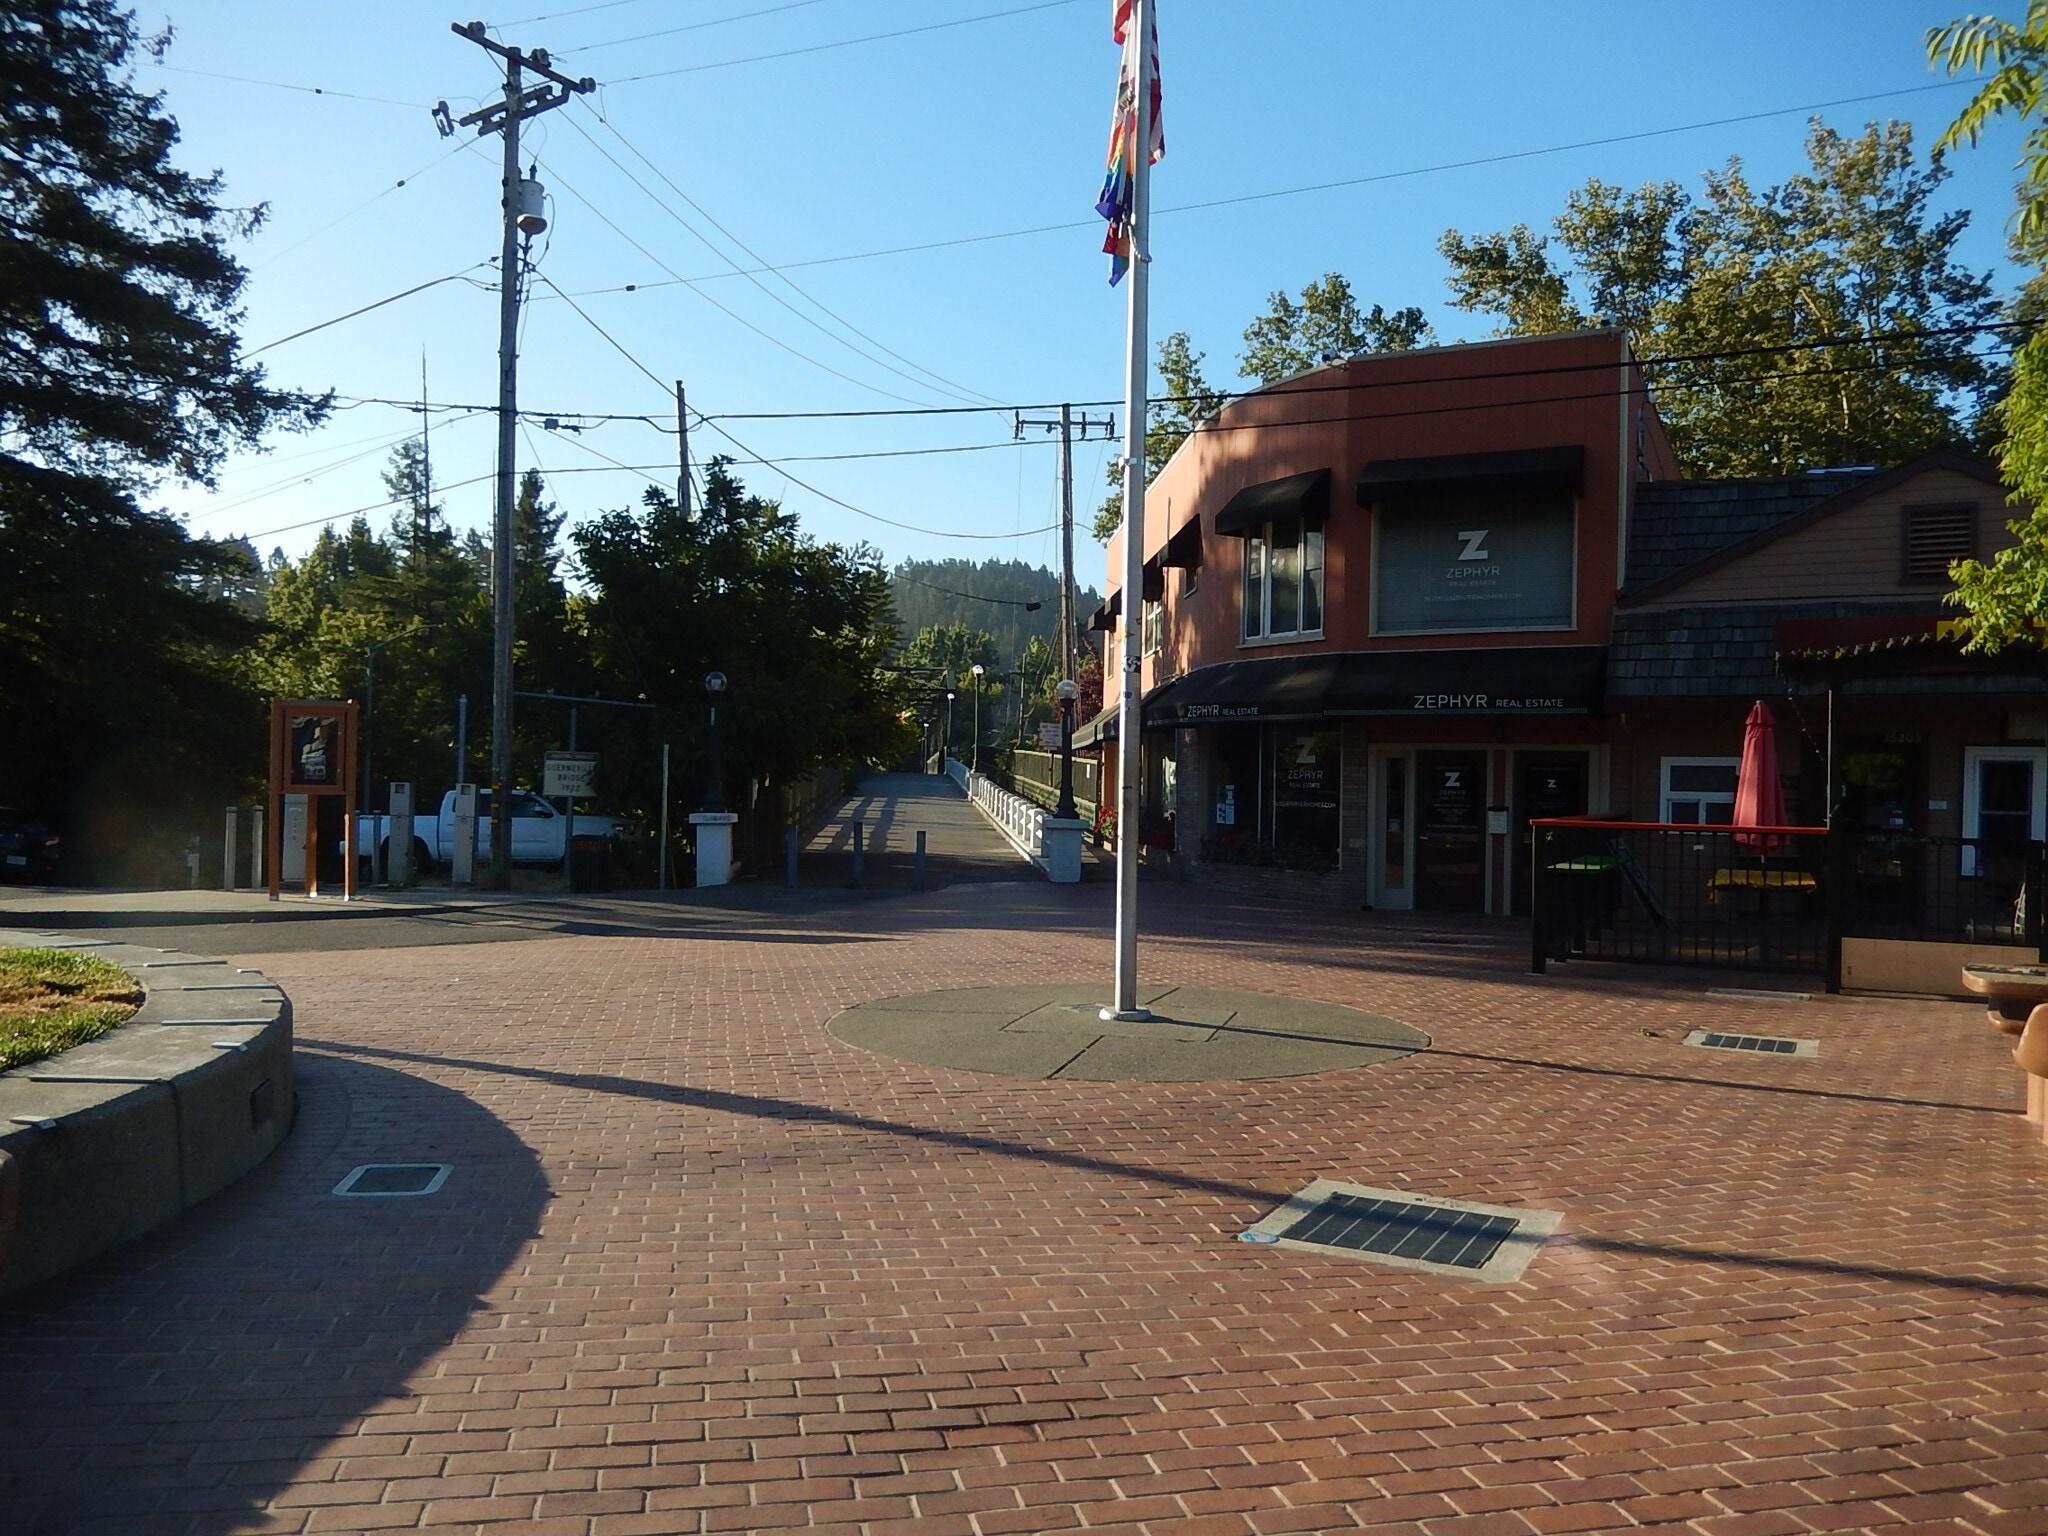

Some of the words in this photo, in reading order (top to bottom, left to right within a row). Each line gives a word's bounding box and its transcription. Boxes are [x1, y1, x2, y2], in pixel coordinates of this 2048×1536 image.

[1458, 530, 1489, 561] Z
[1446, 566, 1500, 579] ZEPHYR
[1413, 694, 1488, 709] ZEPHYR
[1496, 699, 1523, 708] REAL
[1525, 698, 1564, 708] ESTATE
[1187, 704, 1220, 718] ZEPHYR
[1222, 707, 1236, 716] REAL
[1237, 706, 1259, 716] ESTATE
[1288, 770, 1324, 780] ZEPHYR
[1444, 771, 1461, 787] Z
